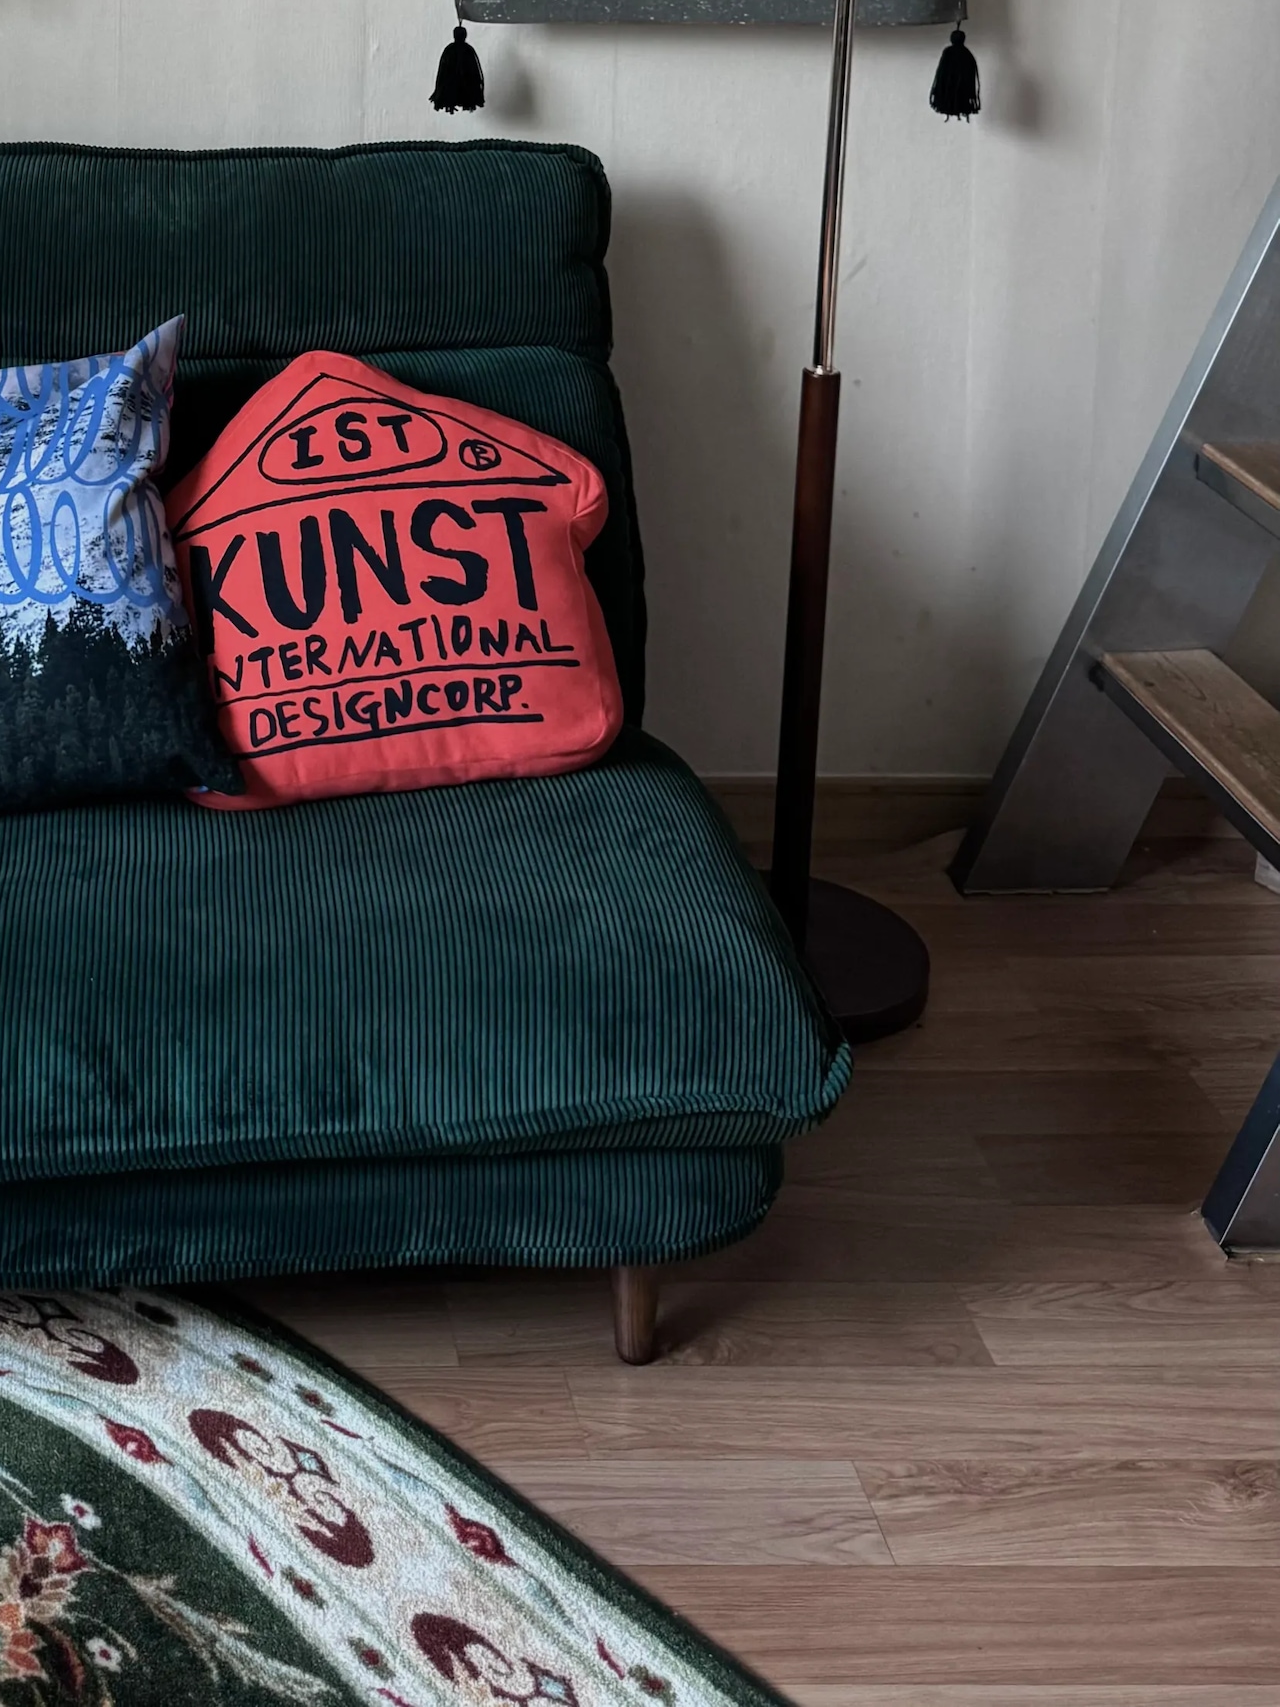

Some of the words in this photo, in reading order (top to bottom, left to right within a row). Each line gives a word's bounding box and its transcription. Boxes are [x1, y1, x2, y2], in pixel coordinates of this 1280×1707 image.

[287, 411, 412, 470] IST
[189, 497, 548, 655] KUNST
[213, 614, 574, 698] NTERNATIONAL
